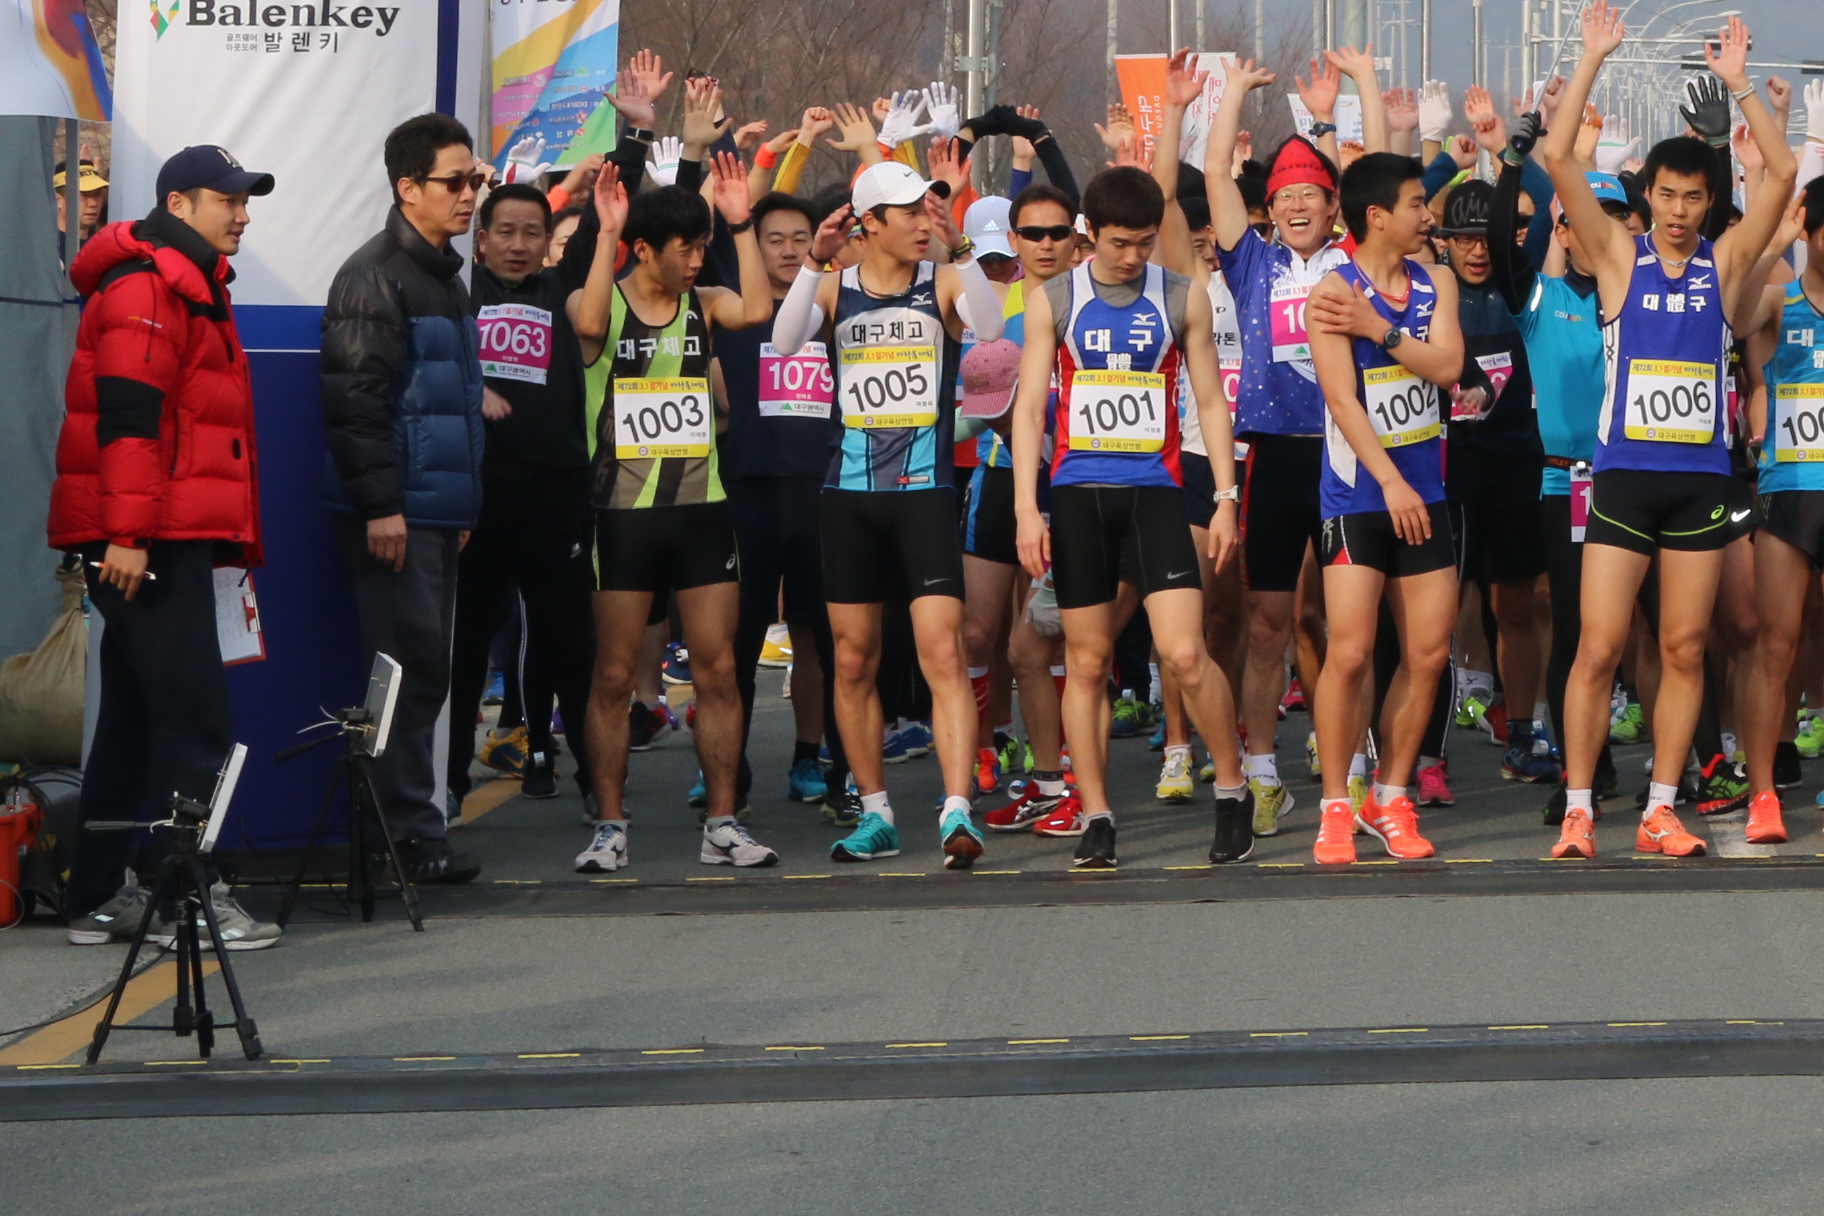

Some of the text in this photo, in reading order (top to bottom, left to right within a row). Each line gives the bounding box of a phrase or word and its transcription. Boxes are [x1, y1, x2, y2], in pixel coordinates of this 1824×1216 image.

[479, 320, 546, 358] 1063
[768, 360, 834, 393] 1079
[848, 363, 928, 413] 1005
[622, 394, 704, 443] 1003
[1078, 390, 1156, 435] 1001
[1375, 379, 1436, 432] 1002
[1633, 381, 1711, 425] 1006
